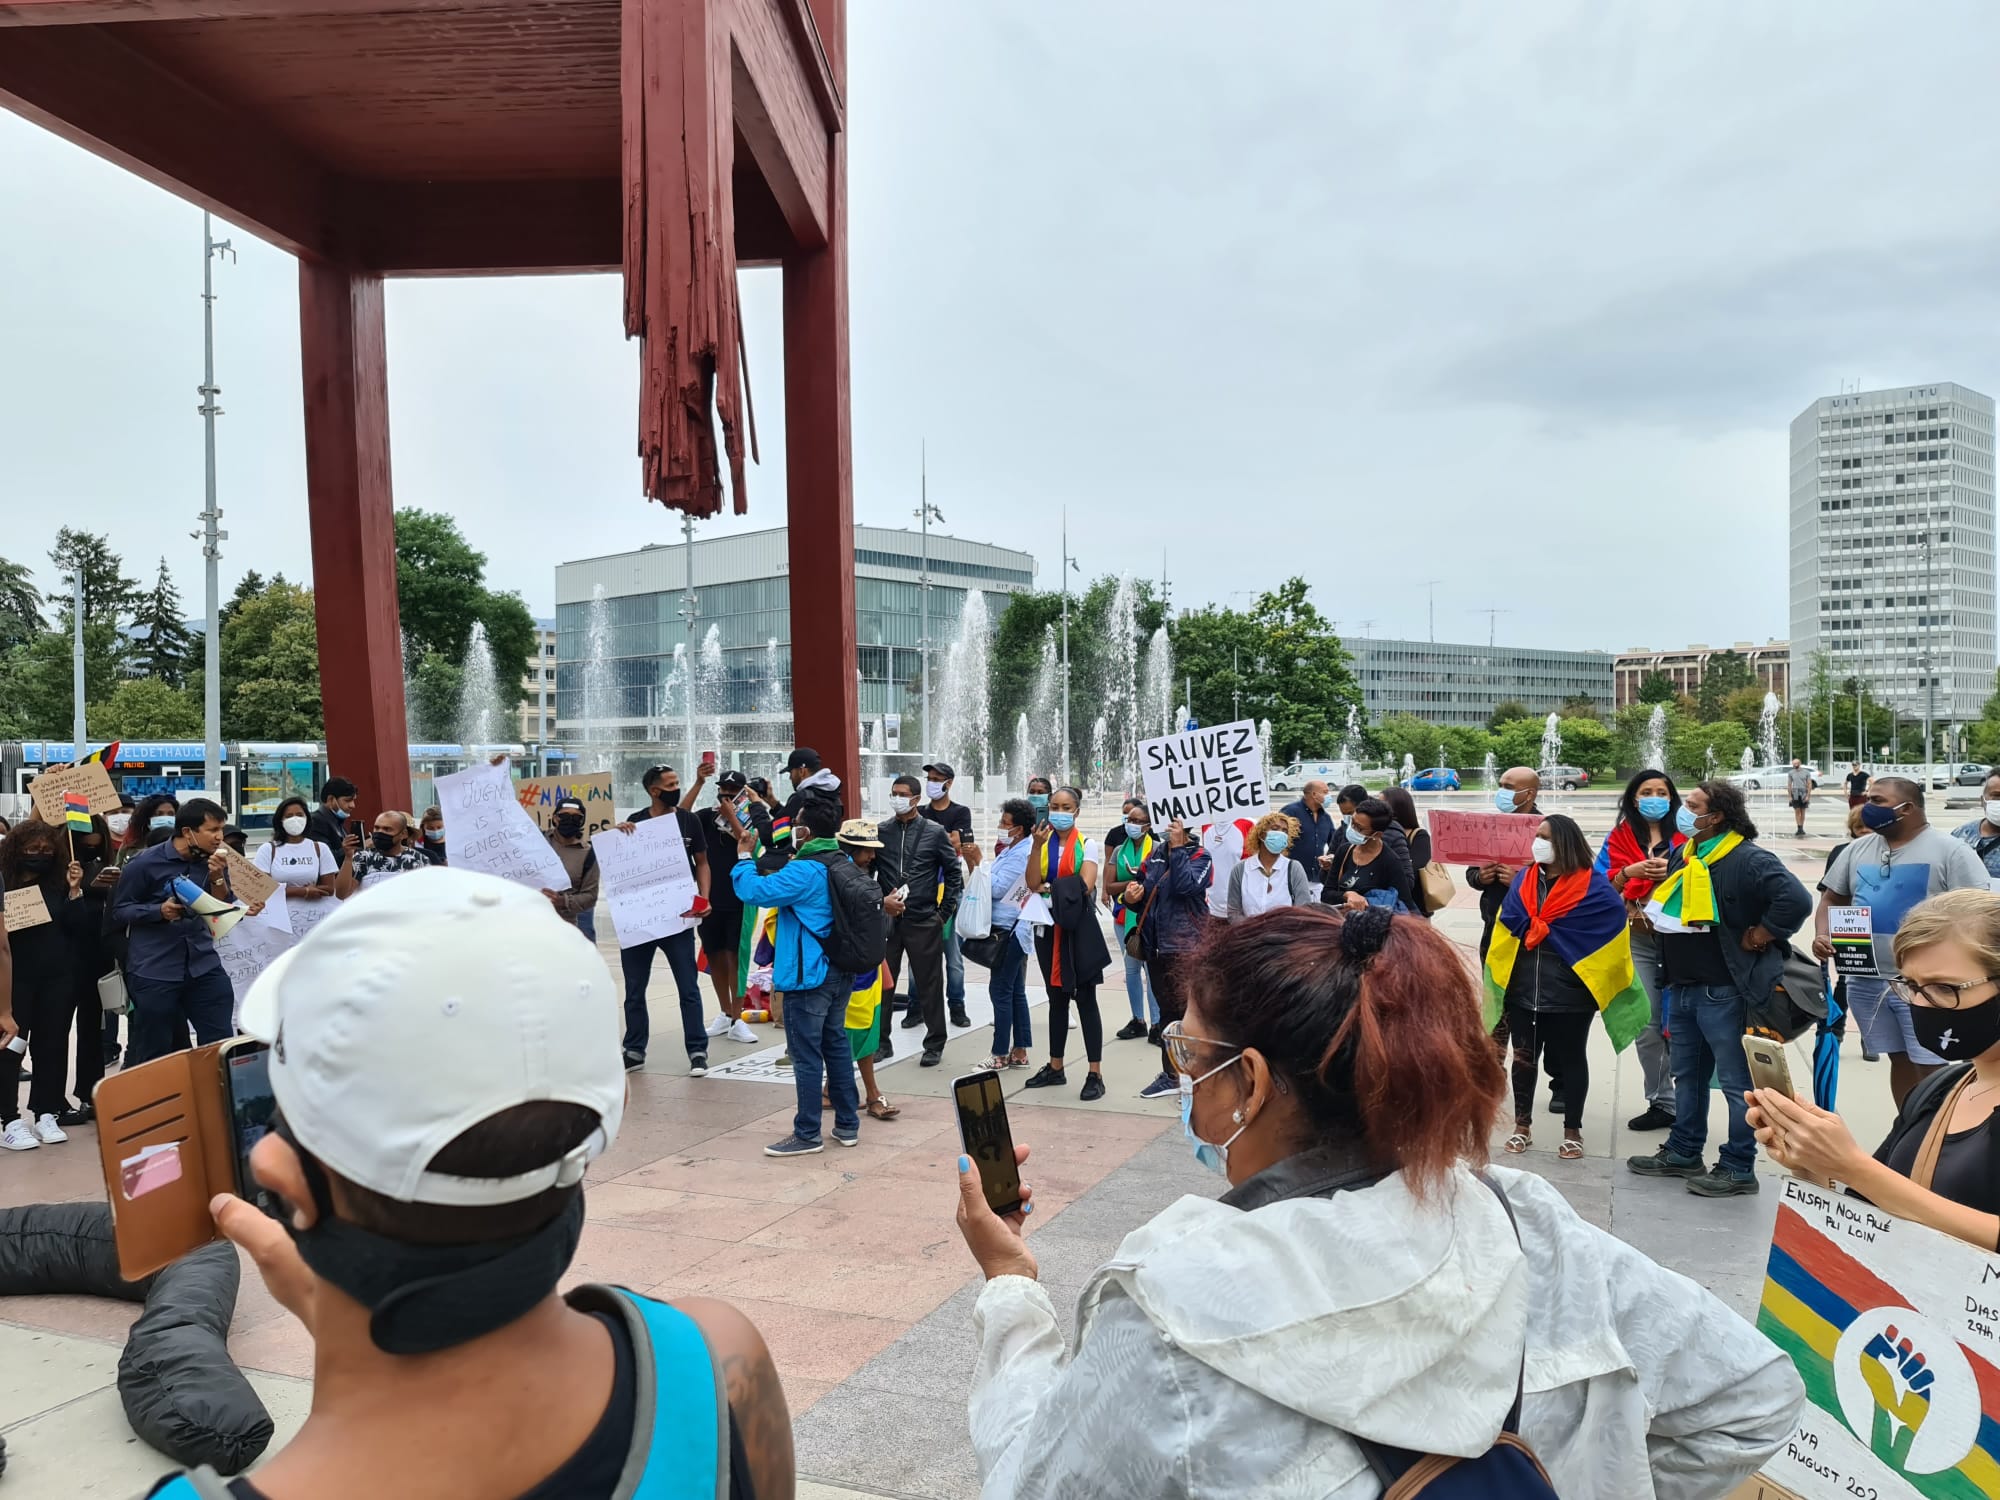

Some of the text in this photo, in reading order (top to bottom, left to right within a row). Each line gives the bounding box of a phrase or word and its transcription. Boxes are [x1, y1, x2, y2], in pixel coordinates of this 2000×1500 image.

[1832, 396, 1862, 408] UIT
[1909, 387, 1938, 399] ITU
[1147, 728, 1253, 770] SAUVEZ
[1151, 781, 1265, 824] MAURICE
[488, 847, 523, 868] THE
[1785, 1181, 1831, 1213] ENSAM
[1847, 1224, 1876, 1244] LOIN
[1965, 1295, 1999, 1322] DIAS
[1967, 1319, 1993, 1340] 29th
[1794, 1428, 1819, 1451] VA
[1787, 1442, 1841, 1484] AUGUST
